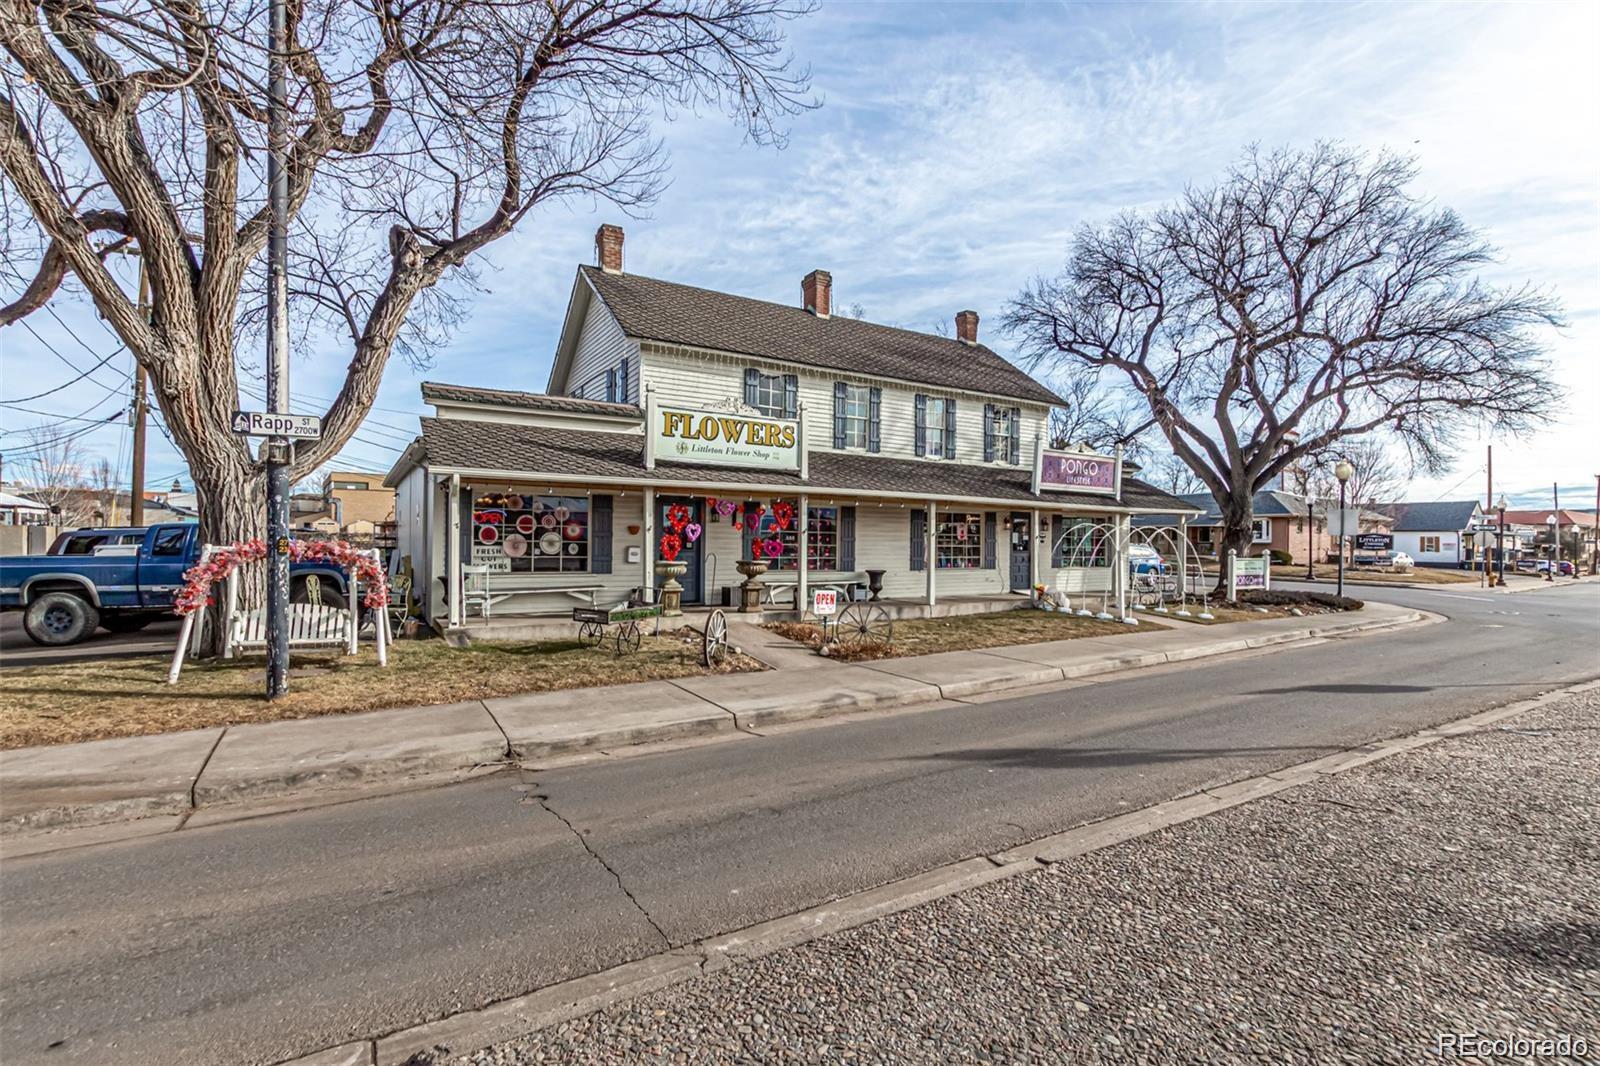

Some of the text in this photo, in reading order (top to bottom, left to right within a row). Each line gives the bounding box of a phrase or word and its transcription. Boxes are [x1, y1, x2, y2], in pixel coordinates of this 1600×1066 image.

[252, 414, 310, 433] Rapp ST
[294, 426, 319, 435] 2700W
[661, 411, 796, 448] FLOWERS
[691, 443, 723, 455] Littleton
[725, 447, 751, 457] Flower
[752, 449, 770, 460] Shop
[816, 594, 835, 605] OPEN
